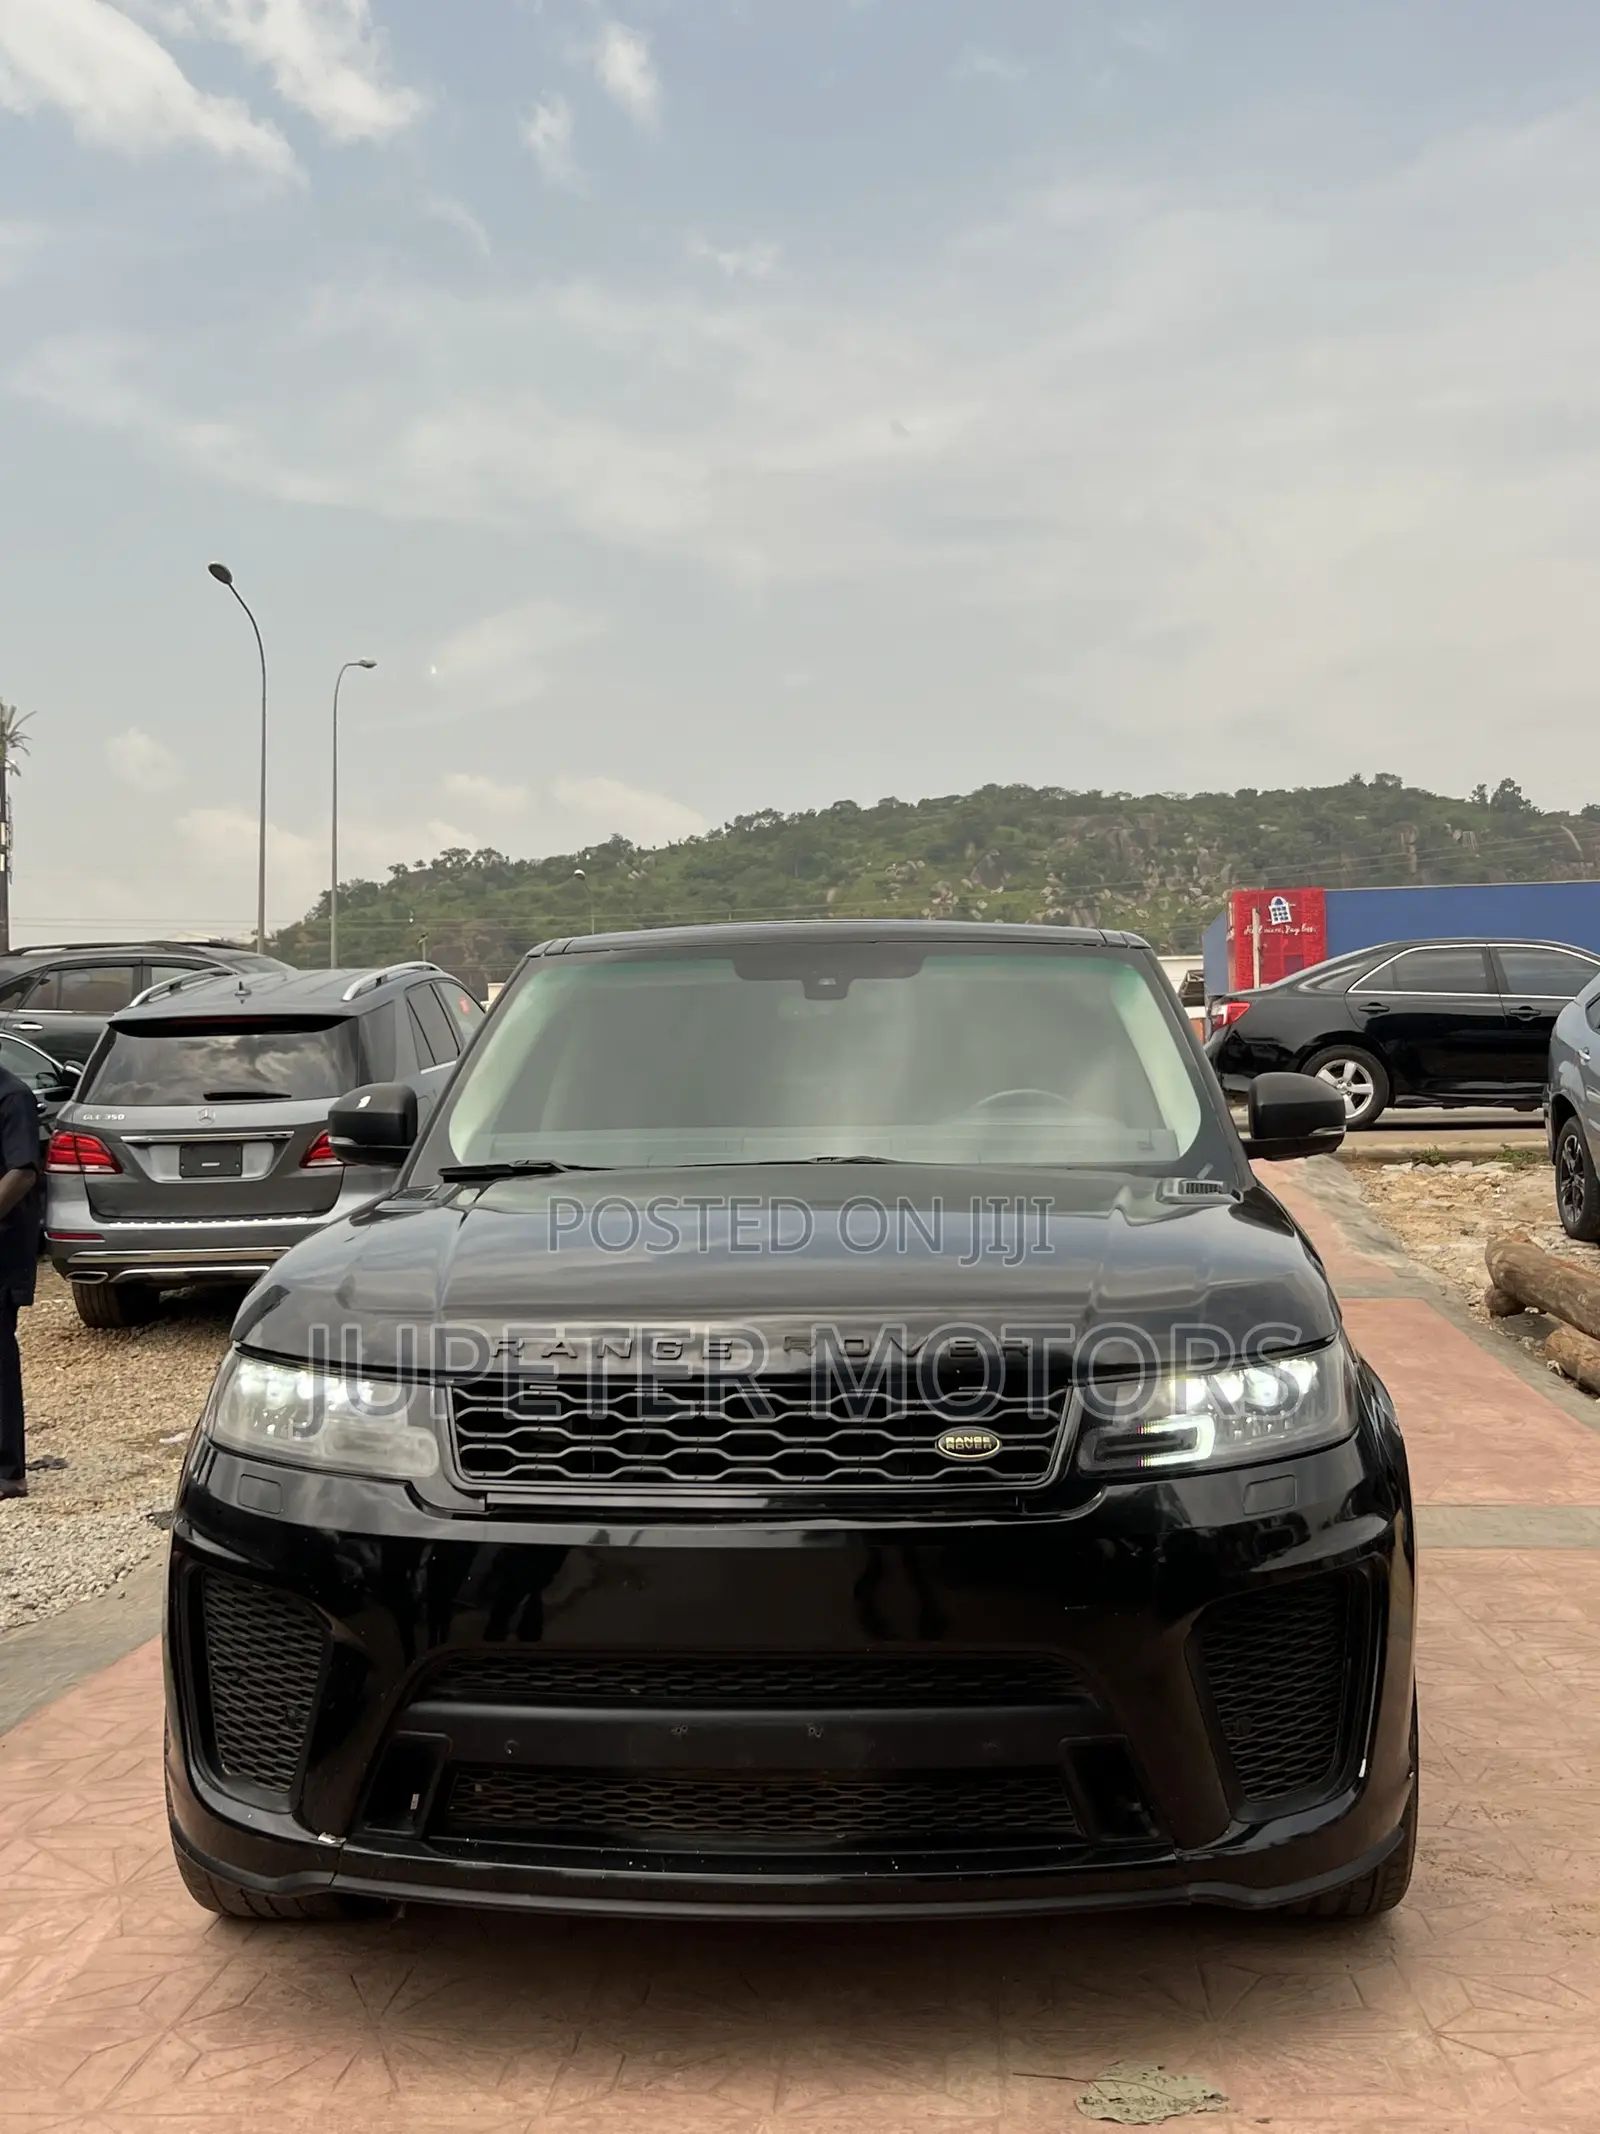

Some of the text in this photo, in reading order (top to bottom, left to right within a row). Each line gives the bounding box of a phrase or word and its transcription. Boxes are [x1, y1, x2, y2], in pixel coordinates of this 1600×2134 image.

[1285, 924, 1300, 936] Pay
[103, 1113, 125, 1121] 350
[490, 1335, 1030, 1359] RANGE ROVER
